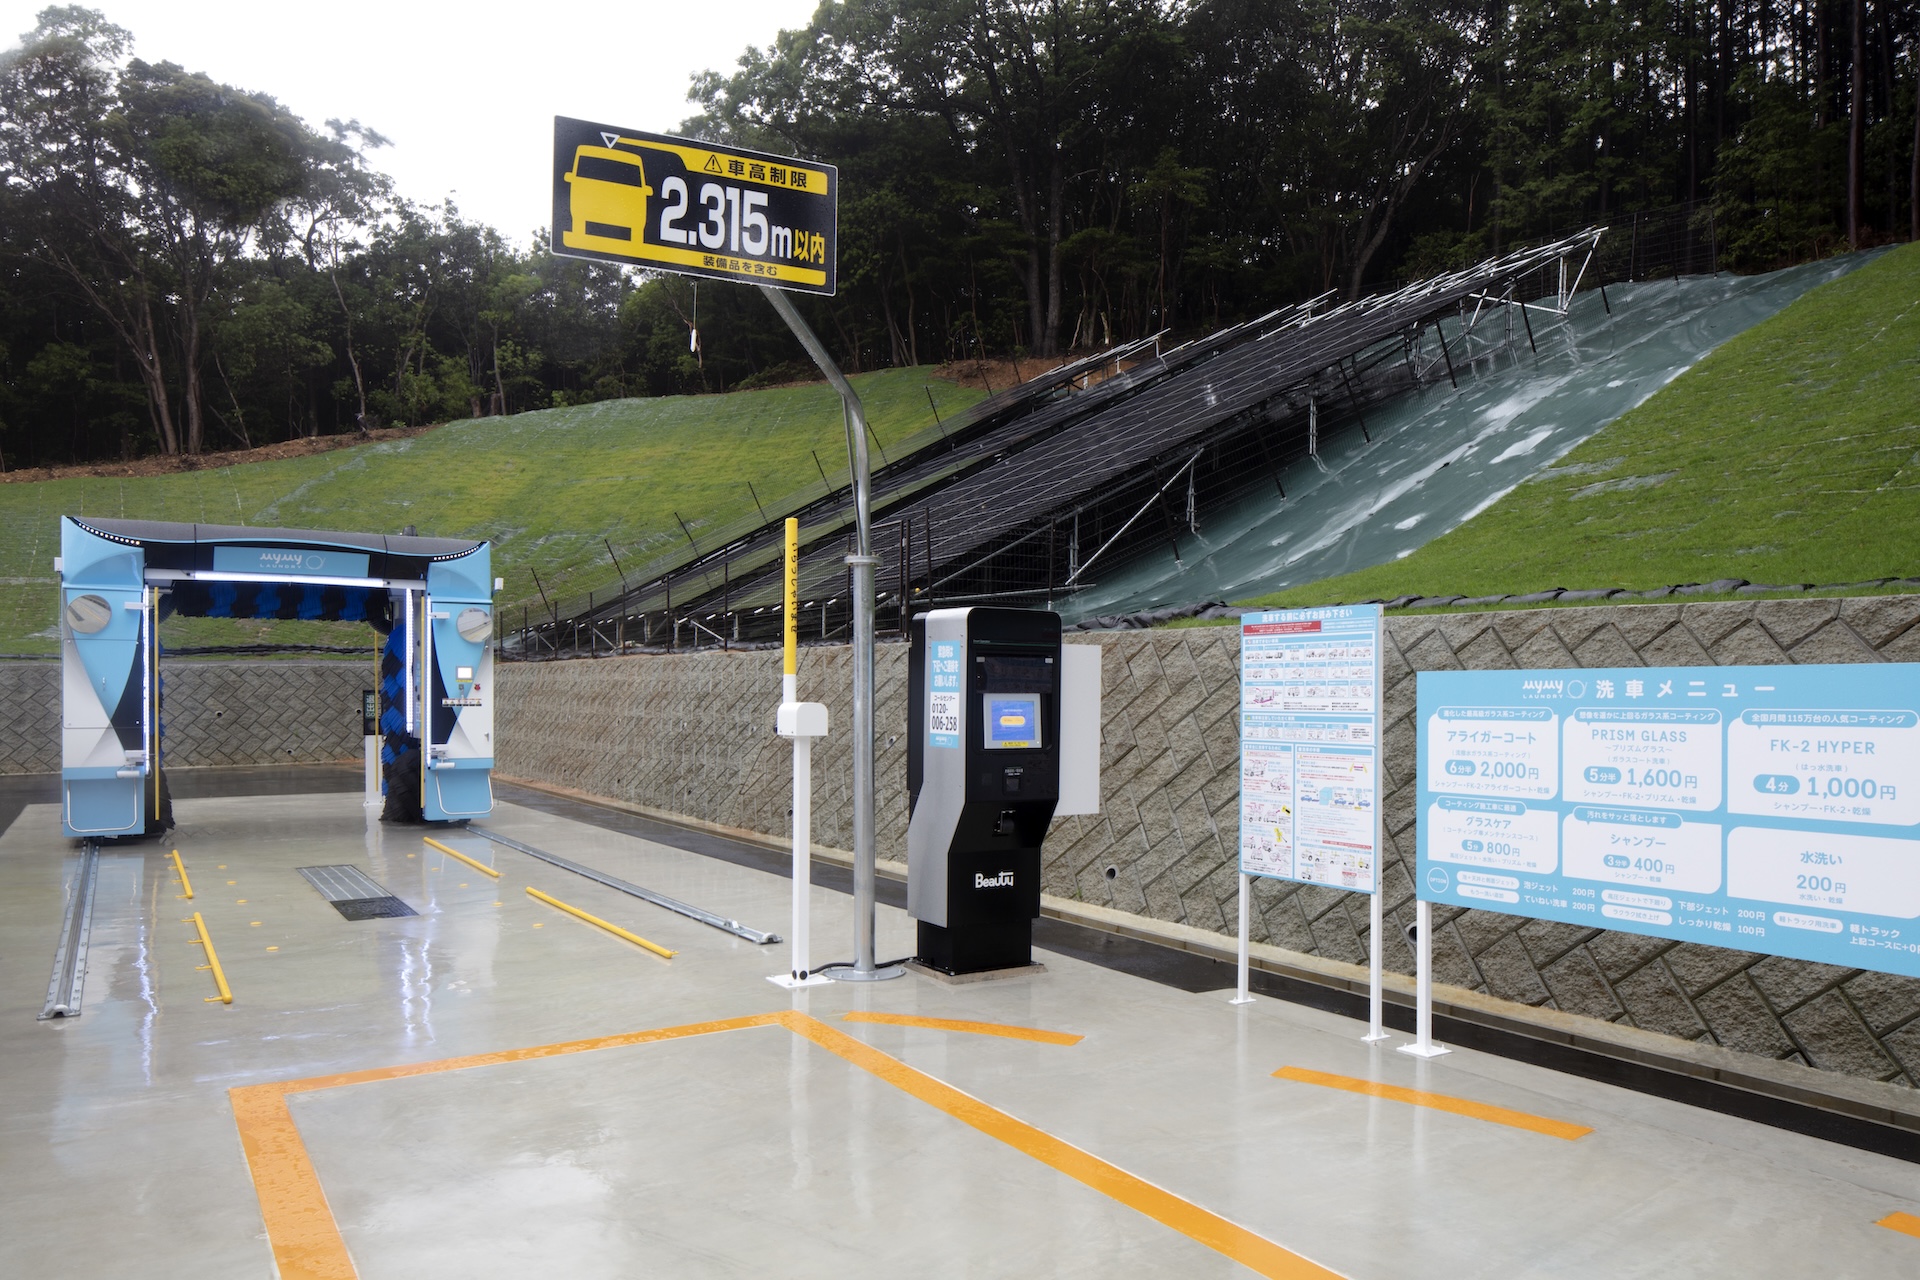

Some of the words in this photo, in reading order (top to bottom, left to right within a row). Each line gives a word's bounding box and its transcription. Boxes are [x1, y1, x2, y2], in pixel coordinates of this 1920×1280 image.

[727, 159, 807, 188] 車高制限
[703, 255, 777, 277] 装備品を含む
[1262, 609, 1353, 623] 洗車する前に必ずお読み下さい
[1595, 679, 1775, 699] 洗車メニュー
[931, 703, 948, 714] 0120-
[931, 716, 958, 731] 006-258
[1751, 713, 1906, 724] 全国月間115万台の人気コーティング
[1447, 730, 1537, 745] アライガーコート
[1591, 729, 1635, 741] PRISM
[1641, 730, 1687, 743] GLASS
[1770, 739, 1810, 753] FK-2
[1817, 740, 1875, 755] HYPER
[1480, 761, 1539, 780] 2,000円
[1627, 768, 1698, 789] 1,600円
[1765, 777, 1789, 792] 4分
[1807, 776, 1896, 801] 1,000円
[1465, 816, 1512, 830] グラスケア
[1587, 810, 1667, 824] 汚れをサッと落とします
[1486, 841, 1521, 857] 800円
[1610, 833, 1667, 848] シャンプー
[1633, 857, 1675, 875] 400円
[1800, 851, 1843, 866] 水洗い
[975, 871, 1014, 888] Beauty
[1796, 874, 1846, 894] 200円
[1523, 880, 1559, 893] 泡ジェット
[1572, 888, 1596, 898] 200円
[1524, 895, 1568, 908] ていねい洗車
[1572, 902, 1596, 913] 200円
[1678, 900, 1729, 916] 下部ジェット
[1737, 909, 1766, 921] 200円
[1678, 916, 1732, 932] しっかり乾燥
[1737, 925, 1766, 937] 100円
[1778, 915, 1838, 930] 軽トラック用洗車
[1850, 923, 1900, 939] 軽トラック
